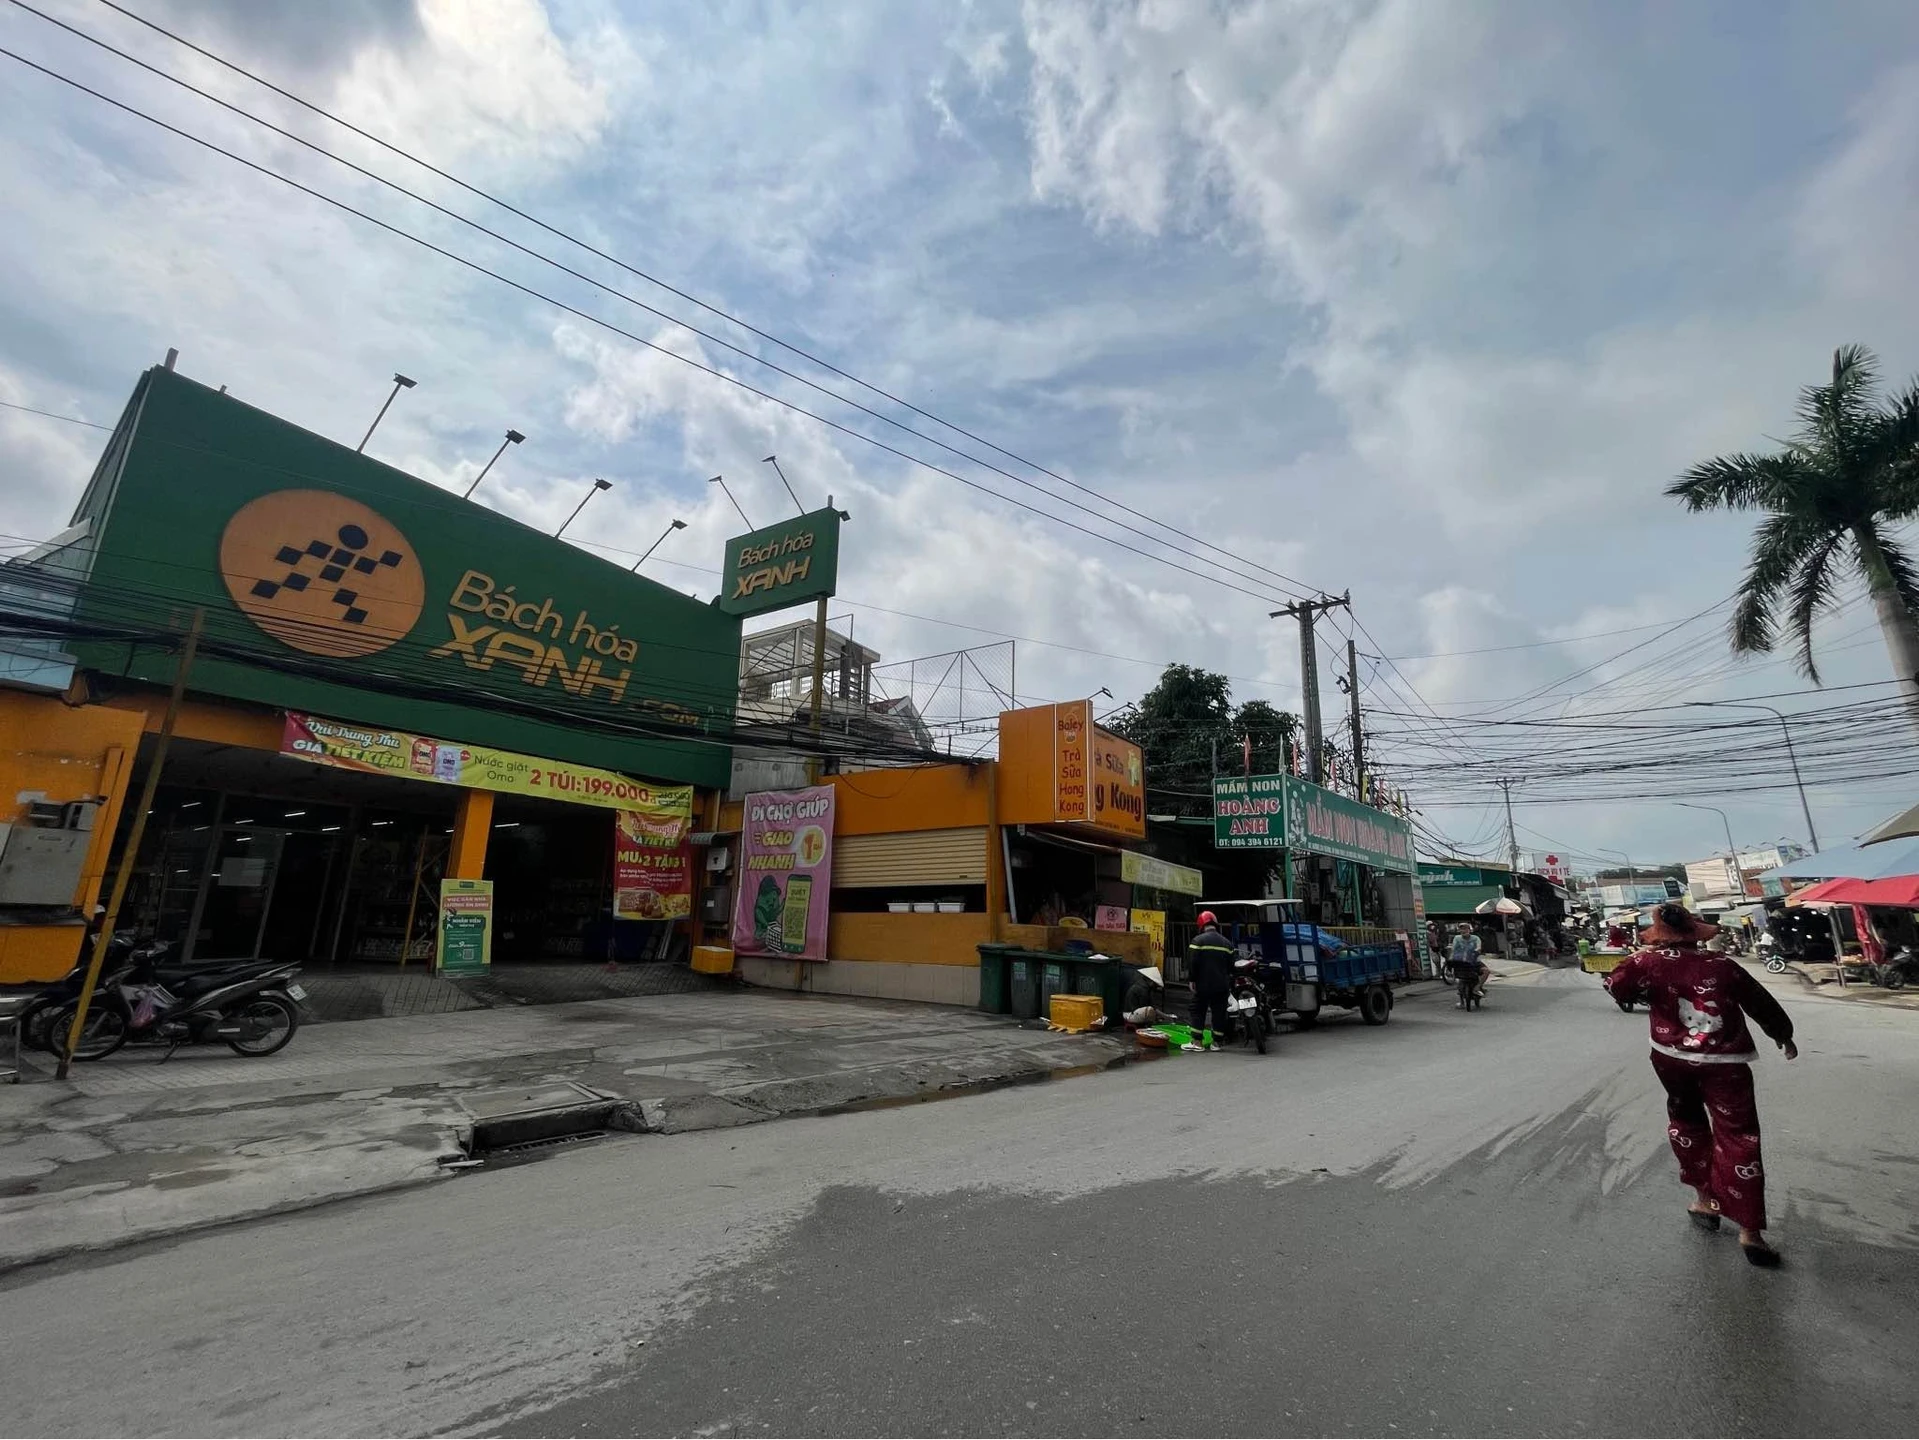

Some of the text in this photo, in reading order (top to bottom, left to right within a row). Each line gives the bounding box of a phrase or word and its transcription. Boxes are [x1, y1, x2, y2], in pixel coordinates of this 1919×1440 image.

[738, 530, 814, 568] Bách hóa
[732, 556, 811, 599] XANH
[449, 569, 638, 663] Bách hóa
[427, 613, 632, 704] XANH
[474, 754, 504, 769] Nước
[1062, 748, 1081, 761] Trà
[486, 770, 515, 783] Omo
[529, 769, 541, 786] 2
[1062, 765, 1082, 778] Sữa
[1060, 783, 1084, 798] Hong
[1252, 780, 1281, 792] NON
[796, 795, 829, 819] GIÚP
[1060, 800, 1085, 814] Kong
[1111, 782, 1141, 822] Kong
[1217, 795, 1281, 816] HOÀNG
[1229, 818, 1269, 835] ANH
[763, 831, 794, 847] GIAO
[748, 853, 796, 870] NHANH
